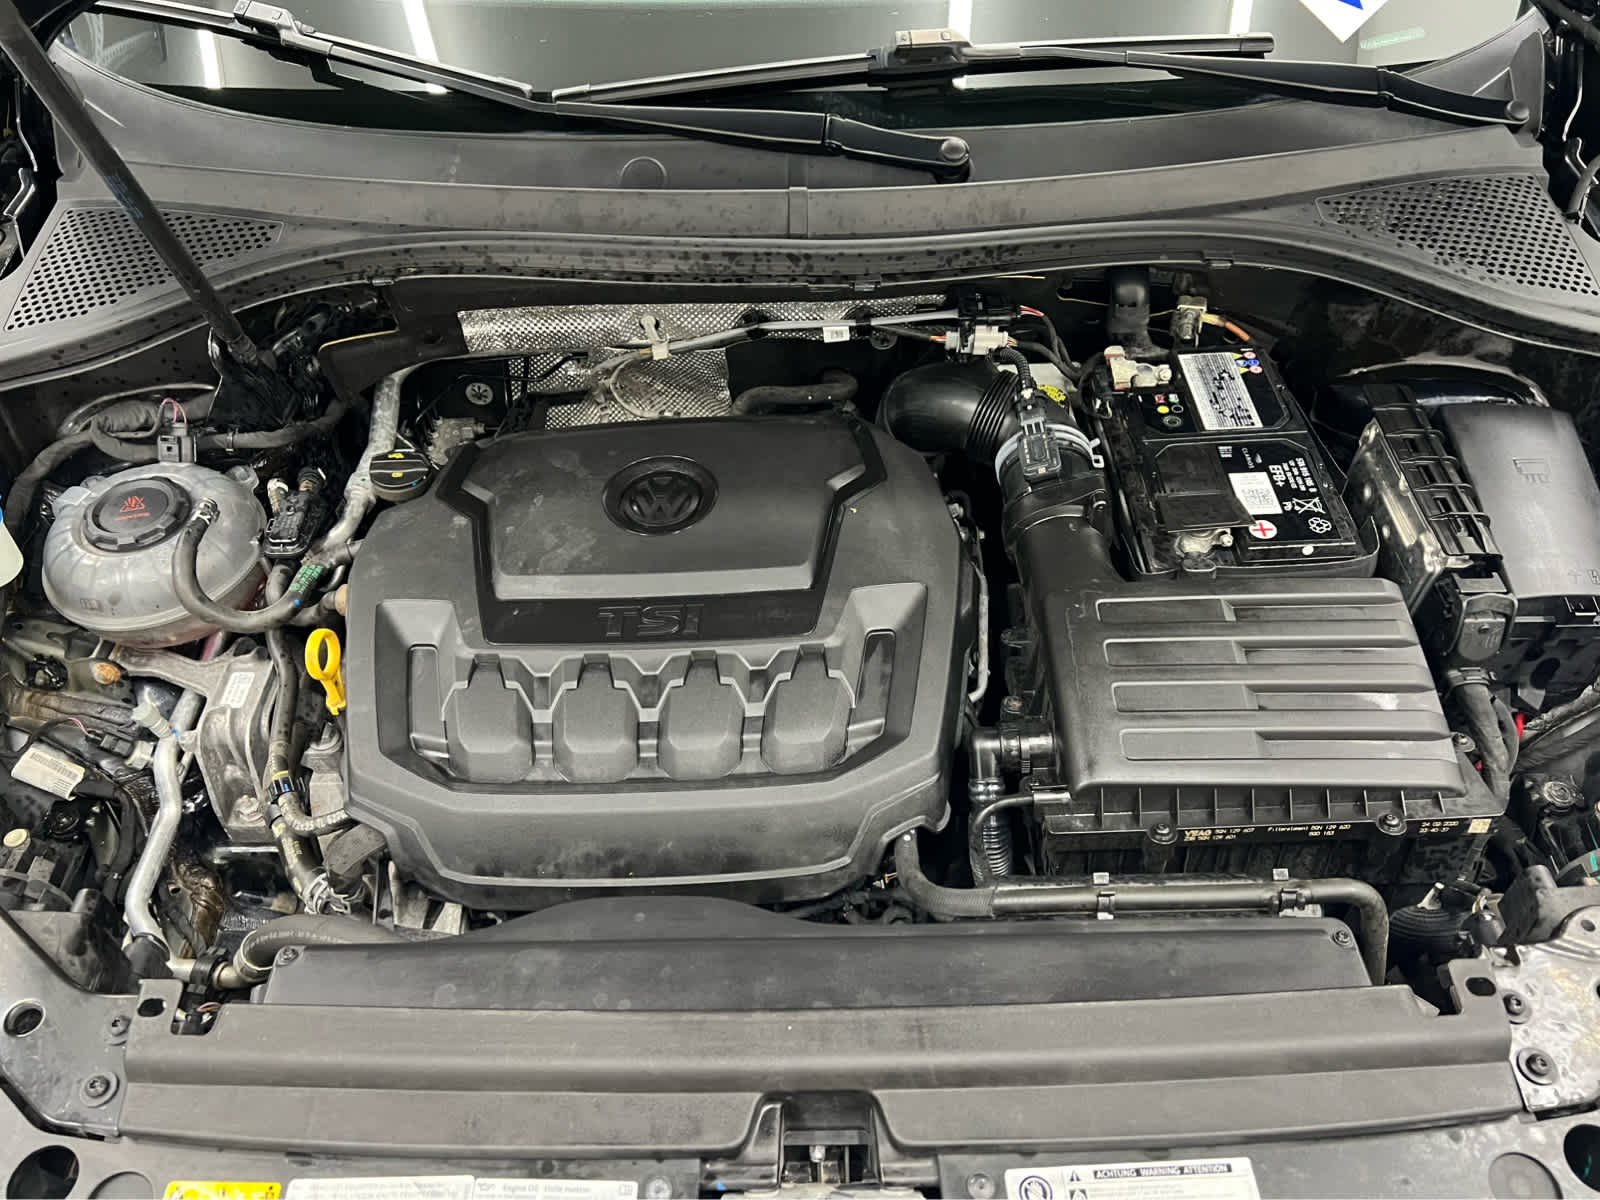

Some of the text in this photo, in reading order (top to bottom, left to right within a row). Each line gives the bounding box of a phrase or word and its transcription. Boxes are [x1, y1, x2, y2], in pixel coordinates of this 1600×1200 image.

[1268, 464, 1287, 487] EFB+
[597, 602, 704, 638] TSI
[1096, 1164, 1229, 1179] ACHTUNG WARNING ATTENTION
